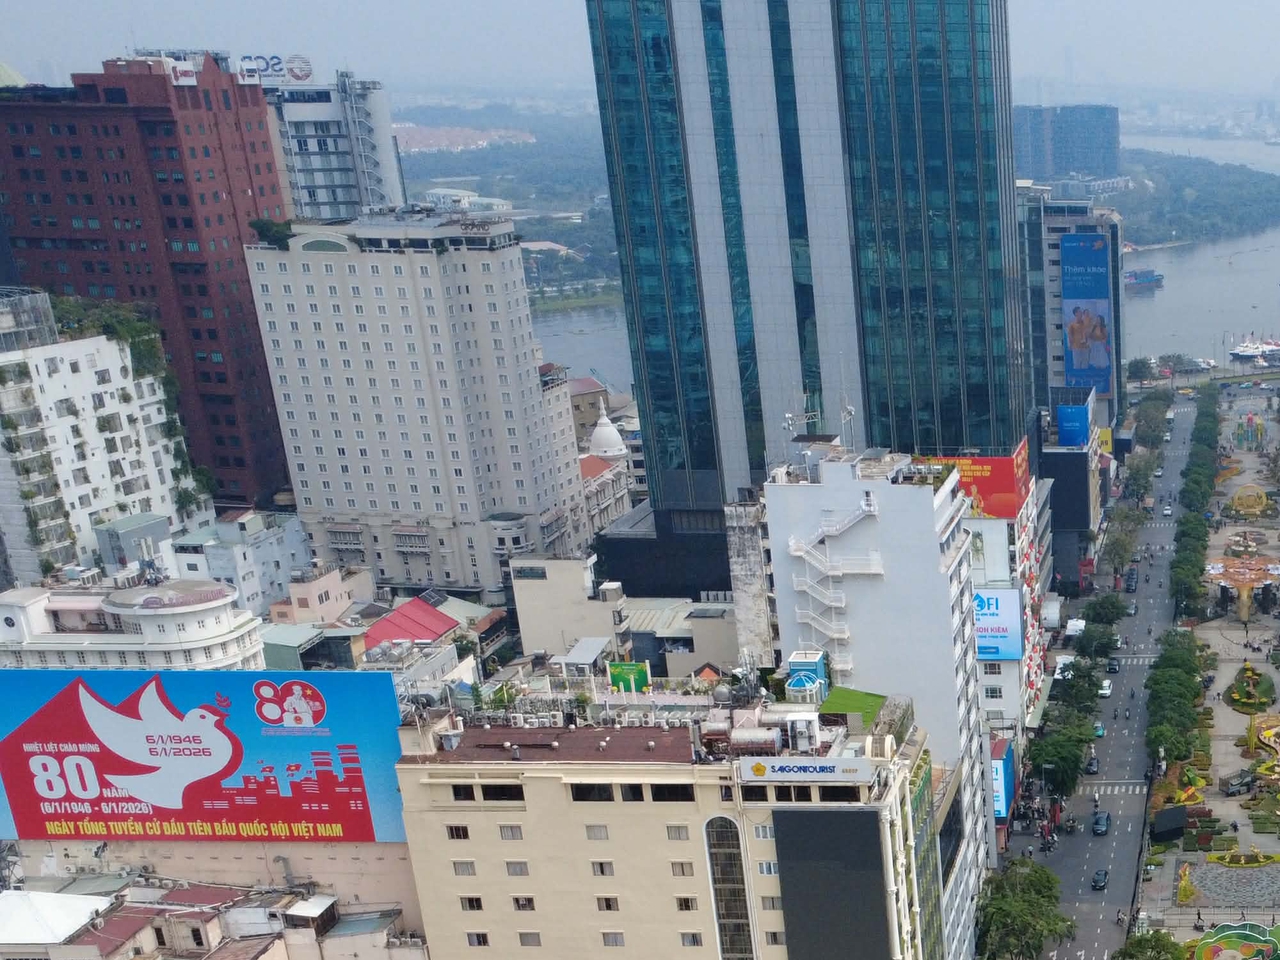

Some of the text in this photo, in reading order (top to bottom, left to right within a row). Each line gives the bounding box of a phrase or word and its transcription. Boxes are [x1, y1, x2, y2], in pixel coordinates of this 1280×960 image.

[146, 735, 202, 745] 6/1/1946
[60, 742, 78, 752] CHÀO
[149, 747, 212, 757] 6/1/2026
[771, 765, 836, 774] SAIGONTOURIST
[28, 755, 101, 799] 80
[102, 787, 129, 797] NĂM
[40, 802, 92, 814] (6/1/1946
[101, 802, 153, 815] 6/1/2026)
[45, 816, 343, 839] NGÀY TỔNG TUYỂN CỬ ĐẦU TIÊN BẦU QUỐC HỘI VIỆT NAM
